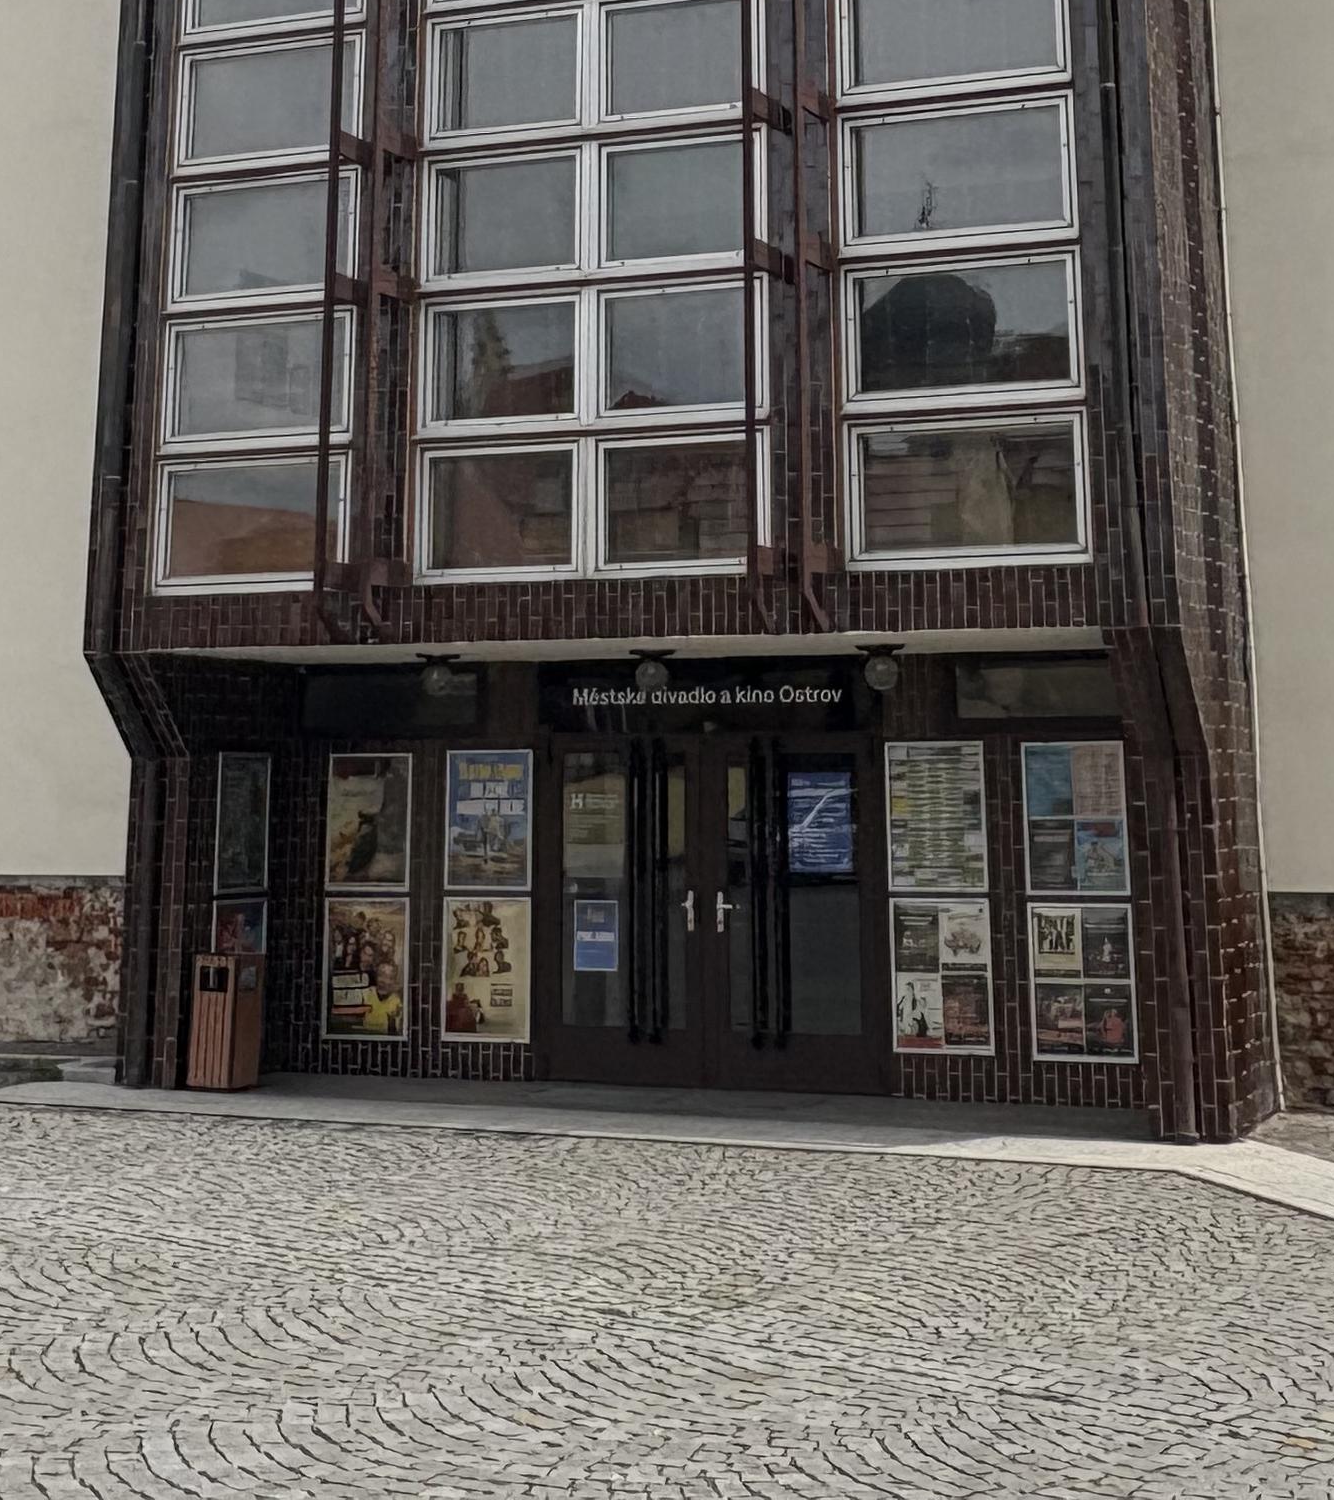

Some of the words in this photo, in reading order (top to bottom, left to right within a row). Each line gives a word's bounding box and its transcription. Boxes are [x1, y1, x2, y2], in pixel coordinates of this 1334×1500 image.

[651, 686, 717, 705] divadlo
[720, 690, 732, 704] a
[736, 685, 774, 704] kino
[779, 684, 842, 703] Ostrov
